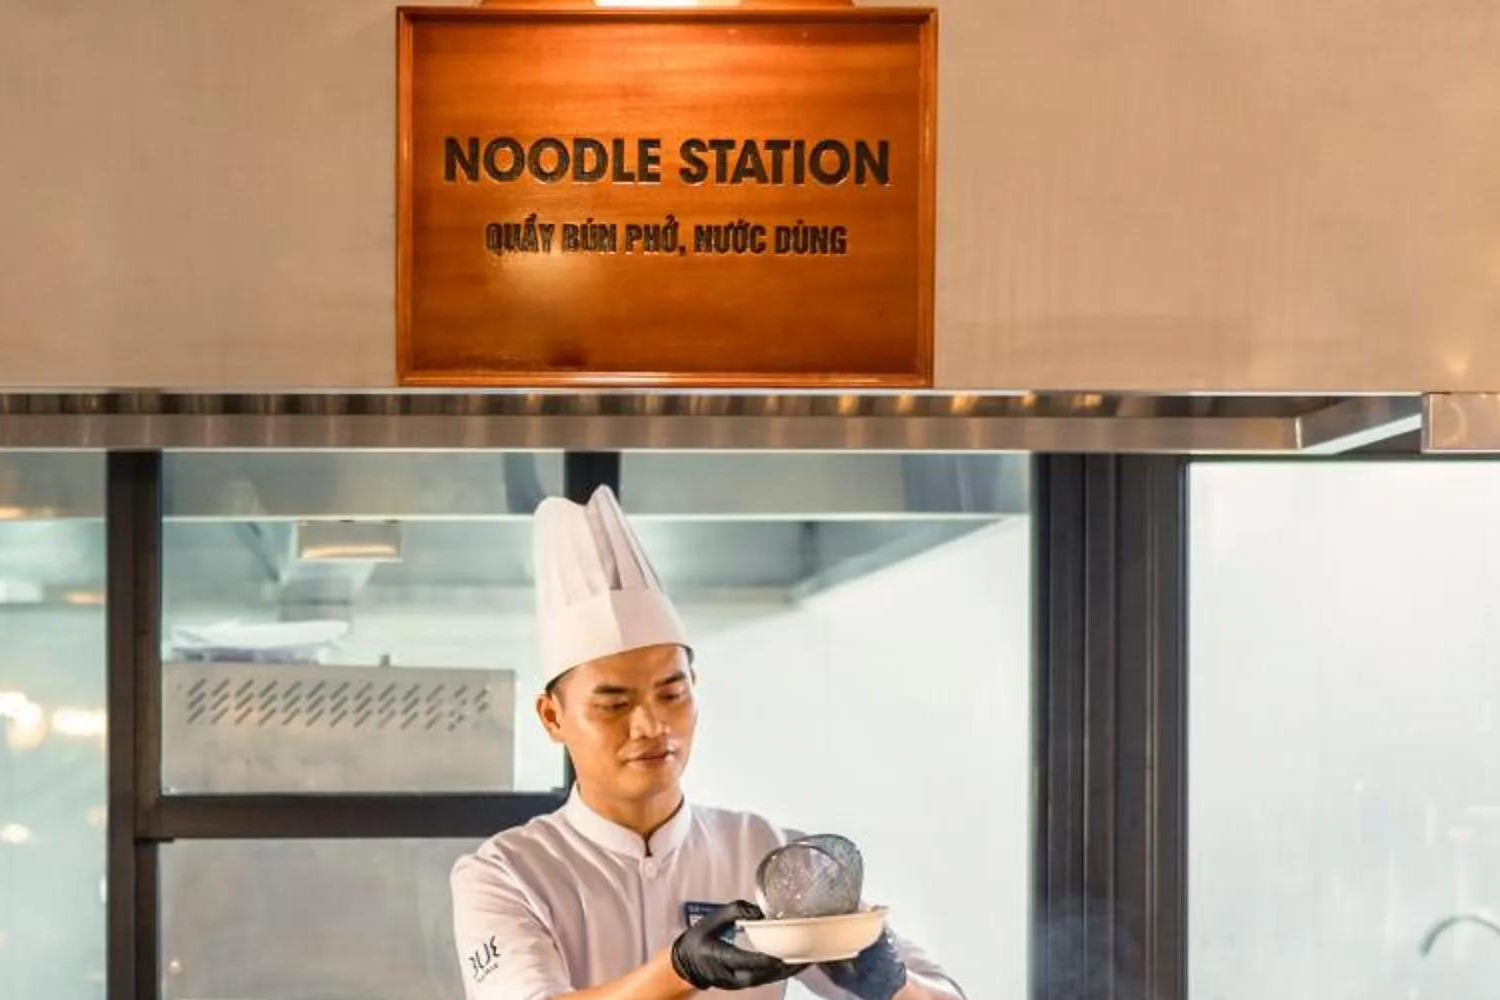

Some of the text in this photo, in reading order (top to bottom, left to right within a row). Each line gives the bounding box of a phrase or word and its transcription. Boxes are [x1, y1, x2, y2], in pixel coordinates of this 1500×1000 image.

[443, 136, 890, 185] NOODLE STATION
[625, 214, 687, 256] PHỞ,
